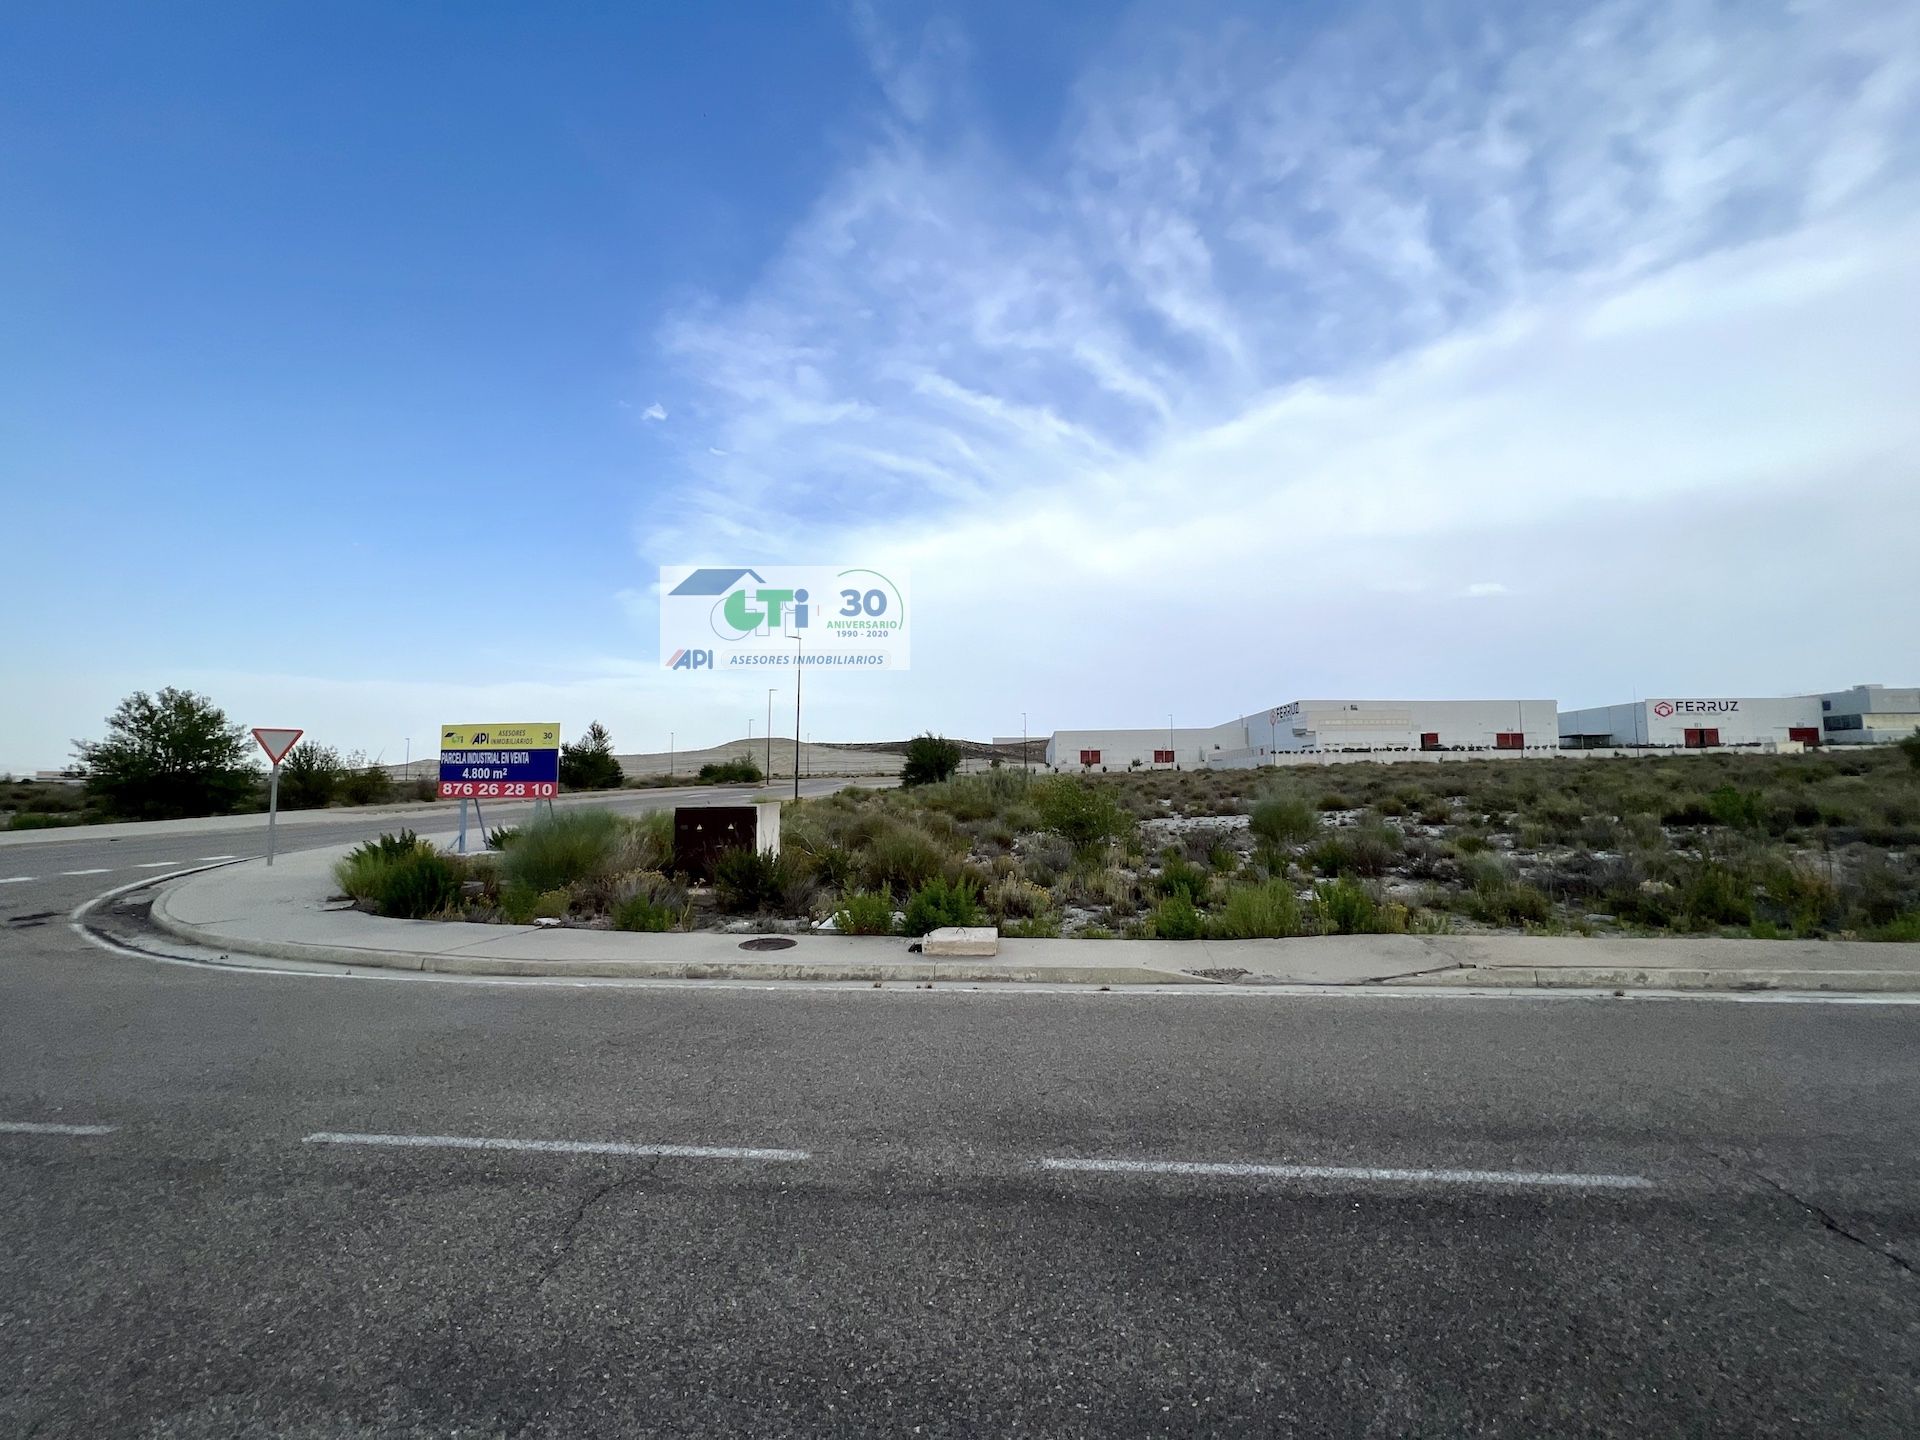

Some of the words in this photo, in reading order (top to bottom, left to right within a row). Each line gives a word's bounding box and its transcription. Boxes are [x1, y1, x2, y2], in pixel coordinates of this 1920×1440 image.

[1675, 701, 1740, 712] FERRUZ
[472, 732, 490, 745] API
[498, 729, 526, 737] ASESORES
[543, 731, 553, 740] 30
[440, 752, 466, 764] PARCELA
[467, 752, 500, 764] INDUSTRIAL
[501, 752, 509, 764] EN
[510, 752, 530, 764] VENTA
[462, 767, 490, 779] 4.800
[442, 783, 473, 795] 876
[478, 783, 499, 795] 26
[504, 783, 526, 796] 28
[532, 783, 553, 796] 10
